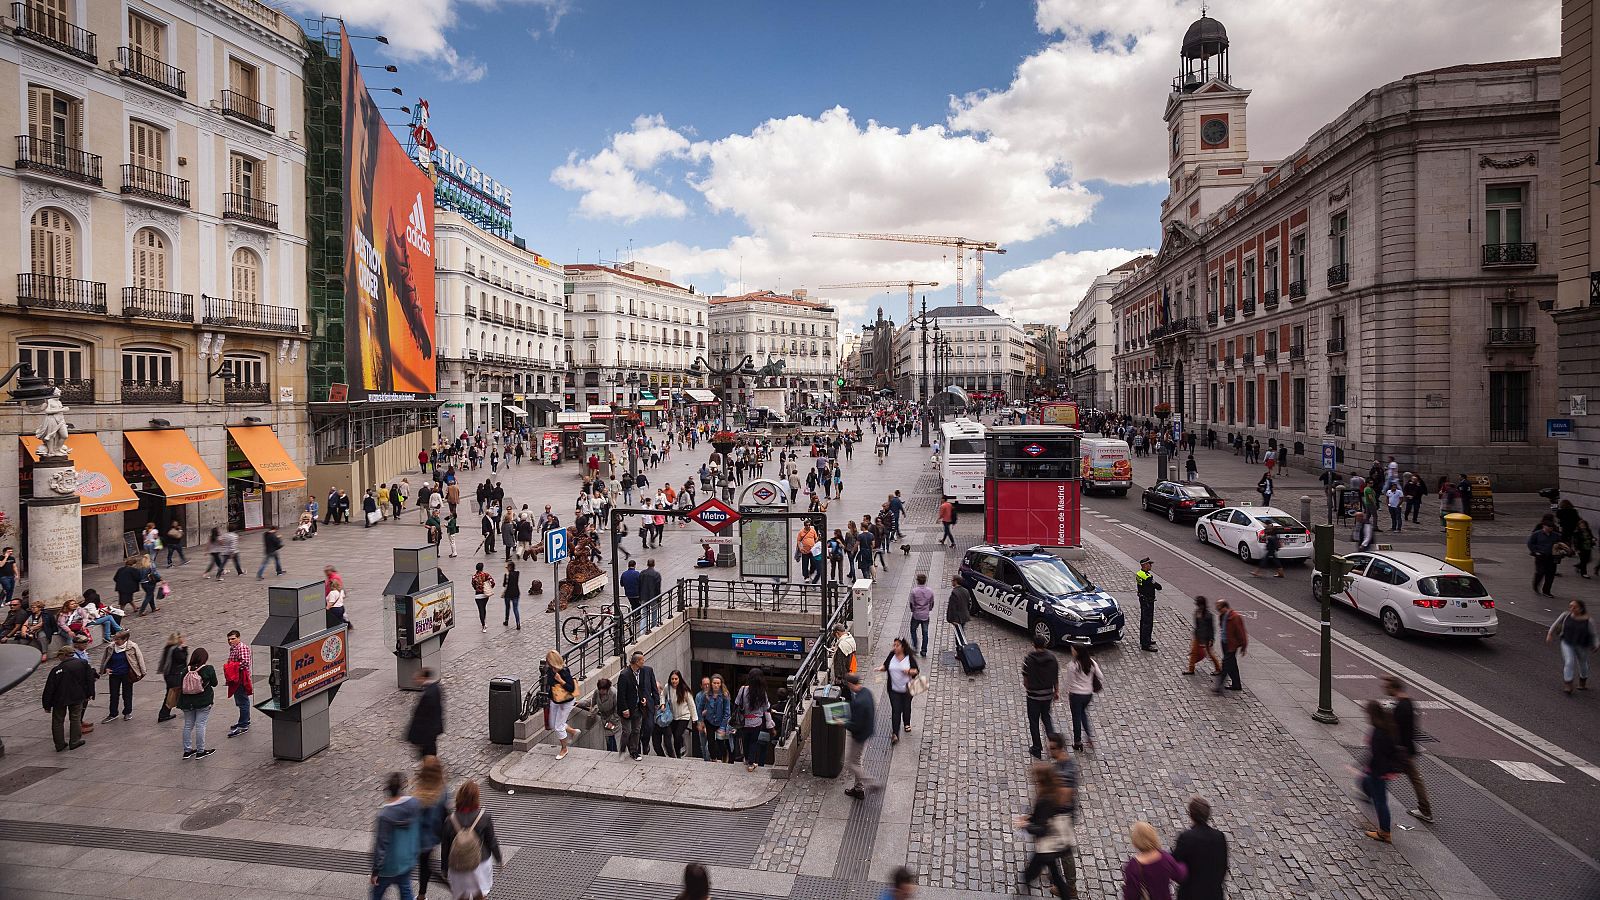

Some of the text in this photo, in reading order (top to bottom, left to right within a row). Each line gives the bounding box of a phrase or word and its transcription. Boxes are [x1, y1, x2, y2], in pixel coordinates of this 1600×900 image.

[438, 144, 467, 180] TIO
[471, 165, 513, 208] PEPE
[354, 224, 382, 276] DESTROY
[406, 225, 431, 257] adidas
[358, 260, 379, 301] ORDER
[89, 503, 119, 513] PICCADILLY
[702, 511, 725, 520] Metro
[1057, 485, 1065, 545] Metro de Madrid
[552, 533, 564, 559] P
[974, 580, 1029, 612] POLICÍA
[988, 602, 1013, 617] MADRID
[754, 639, 787, 648] vodafone Sol
[293, 669, 318, 684] CAMBIO
[322, 658, 345, 672] CHANGE
[295, 653, 315, 671] Ria
[298, 681, 307, 690] NO
